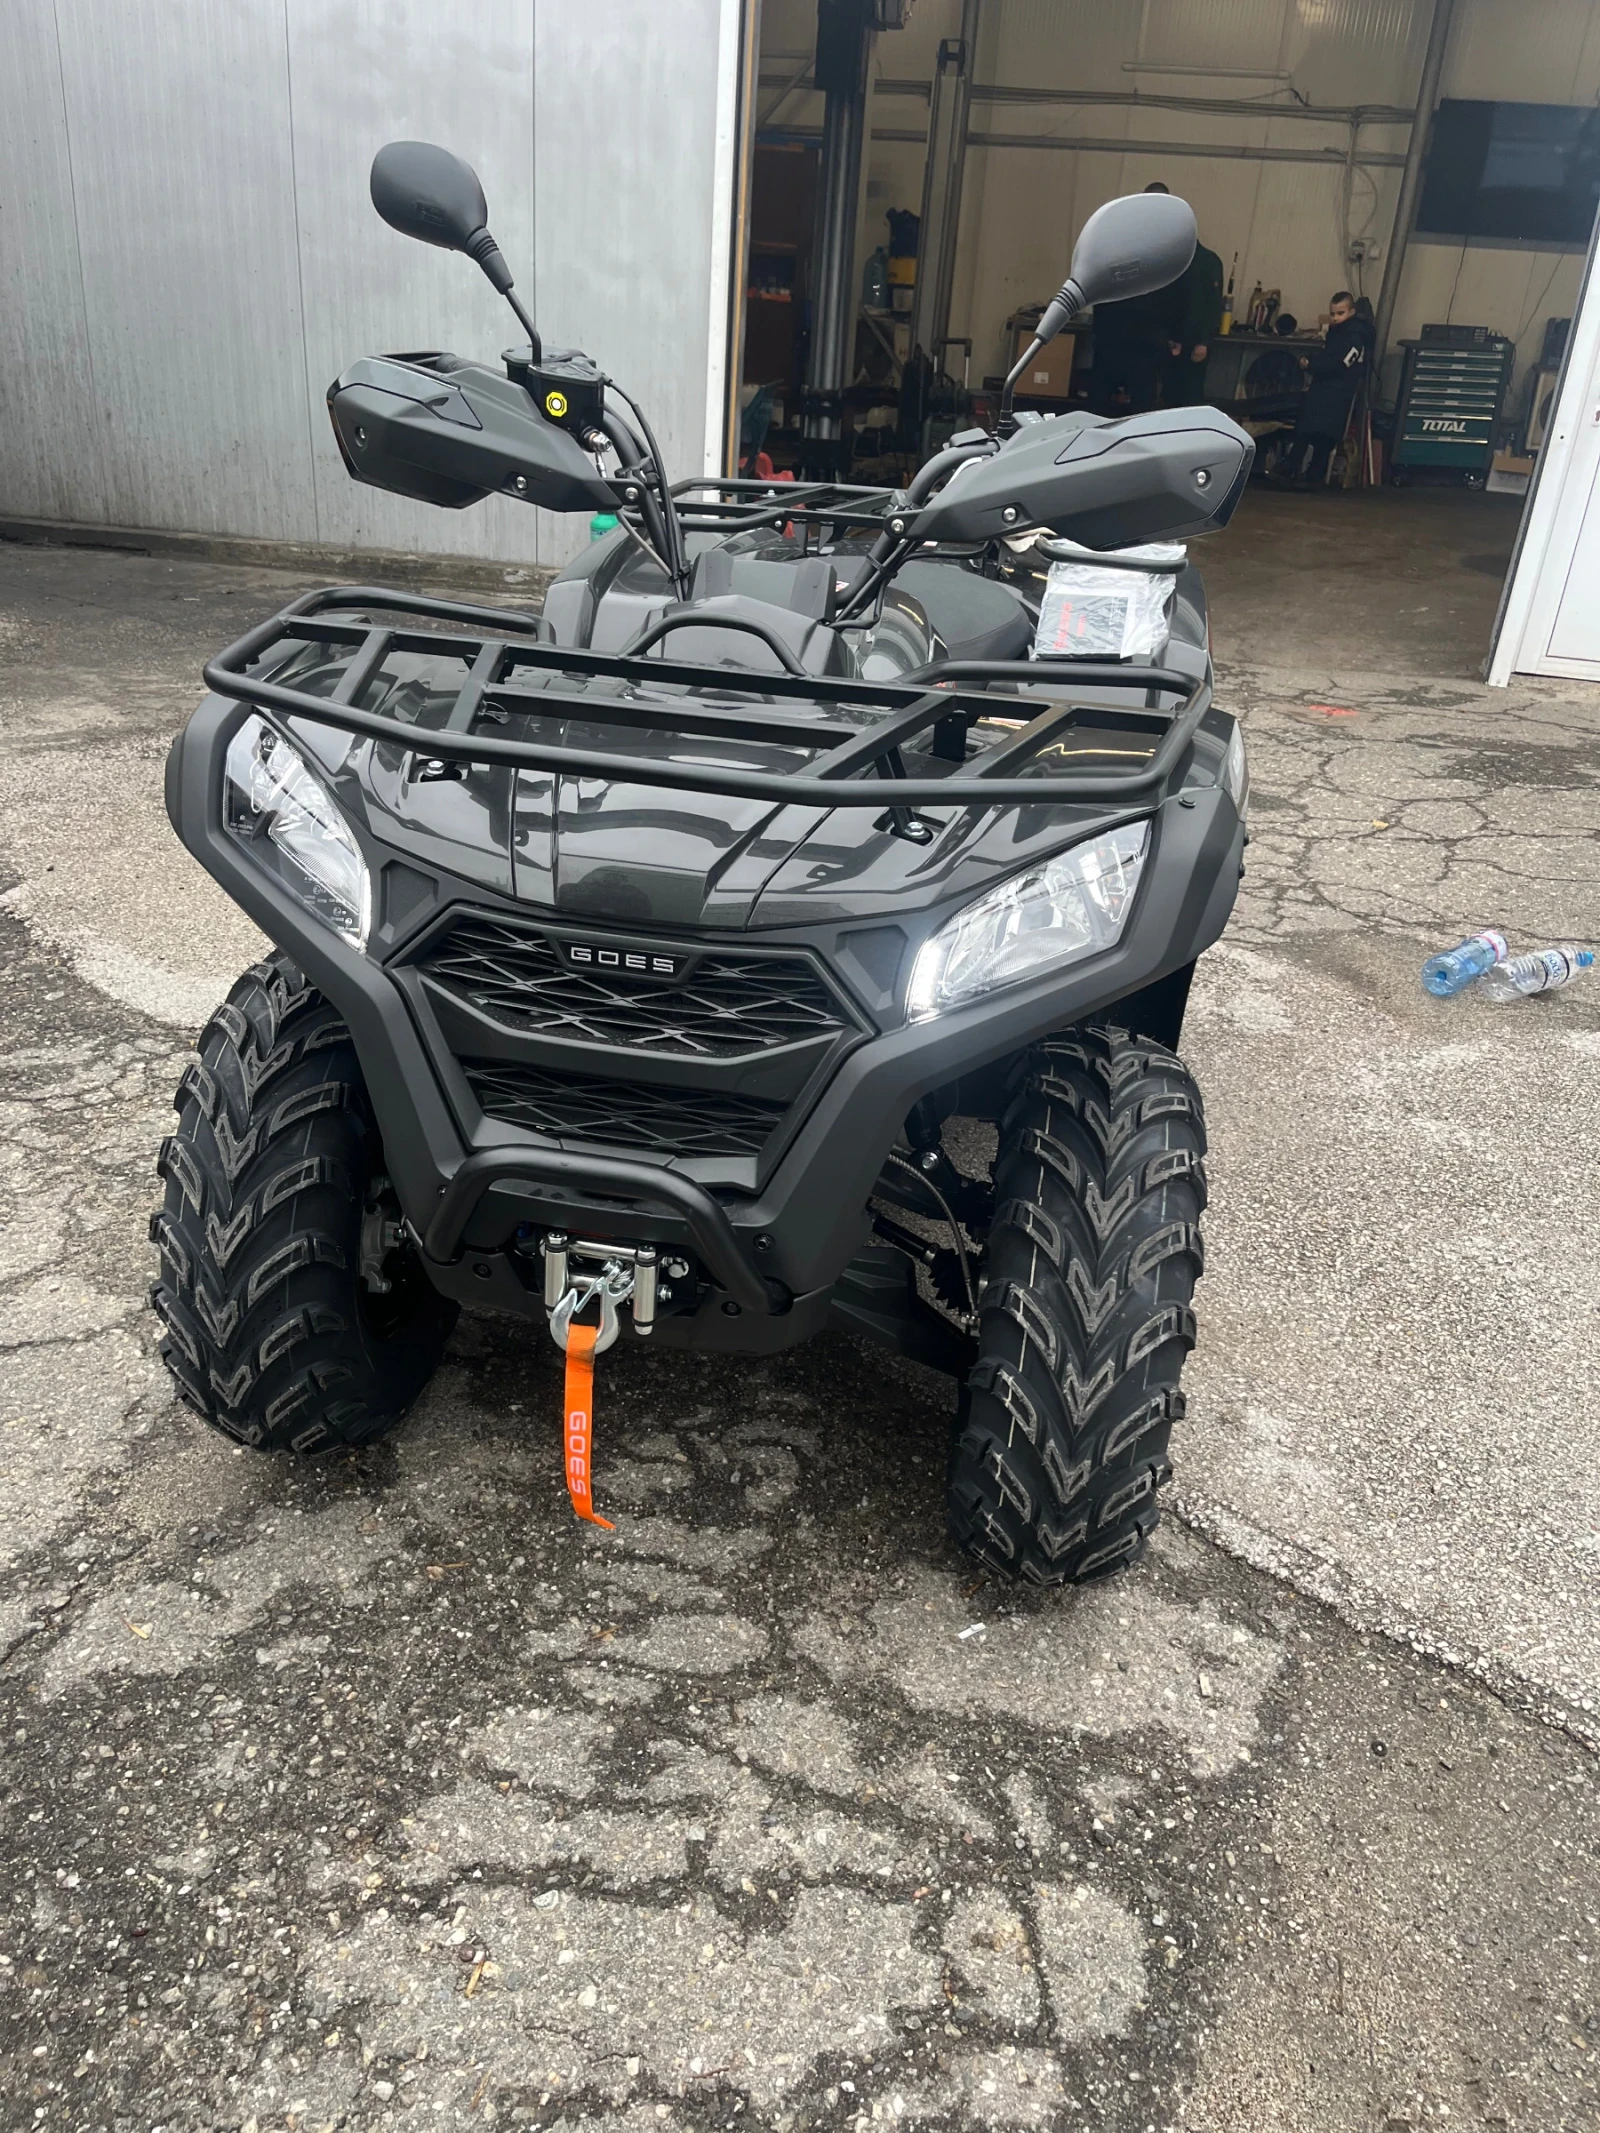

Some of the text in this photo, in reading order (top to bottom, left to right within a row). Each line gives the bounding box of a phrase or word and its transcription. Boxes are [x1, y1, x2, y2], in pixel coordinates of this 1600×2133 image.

[1422, 419, 1466, 432] TOTAL
[571, 946, 674, 973] GOES
[569, 1411, 587, 1496] GOES
